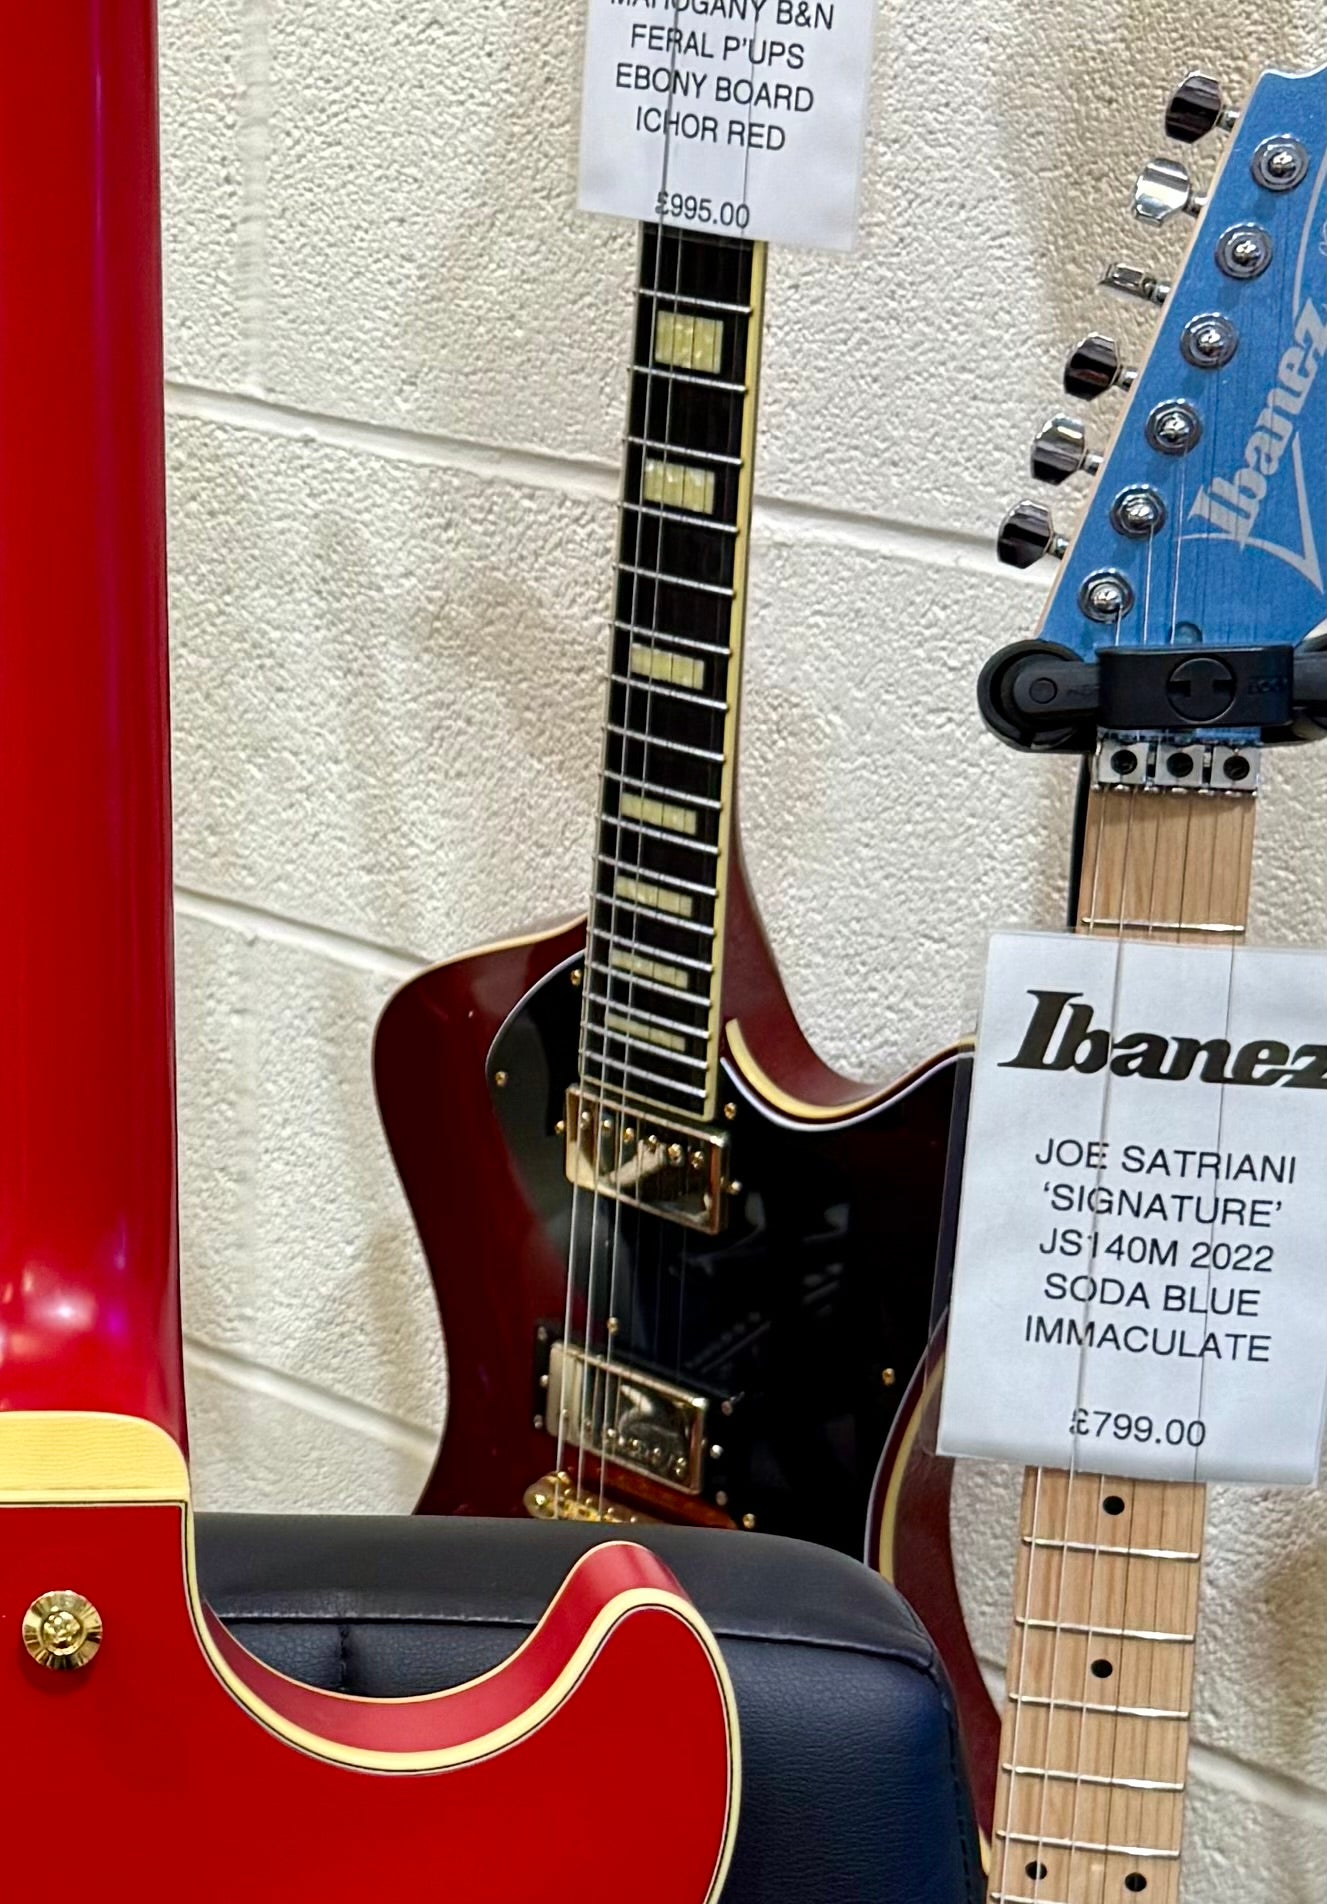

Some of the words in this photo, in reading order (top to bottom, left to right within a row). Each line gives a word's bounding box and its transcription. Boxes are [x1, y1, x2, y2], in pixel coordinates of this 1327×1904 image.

[776, 0, 834, 30] B&N
[631, 24, 714, 58] FERAL
[722, 36, 805, 70] P'UPS
[616, 63, 707, 98] EBONY
[715, 80, 815, 112] BOARD
[636, 106, 718, 141] ICHOR
[727, 120, 786, 151] RED
[655, 191, 751, 229] £995.00
[1187, 298, 1327, 551] Ibanez
[997, 989, 1327, 1090] Ibanez
[1035, 1138, 1109, 1170] JOE
[1121, 1145, 1297, 1184] SATRIANI
[1040, 1229, 1179, 1268] JS140M
[1190, 1243, 1274, 1273] 2022
[1044, 1274, 1149, 1310] SODA
[1164, 1284, 1260, 1317] BLUE
[1025, 1315, 1272, 1363] IMMACULATE
[1069, 1408, 1206, 1447] £799.00
